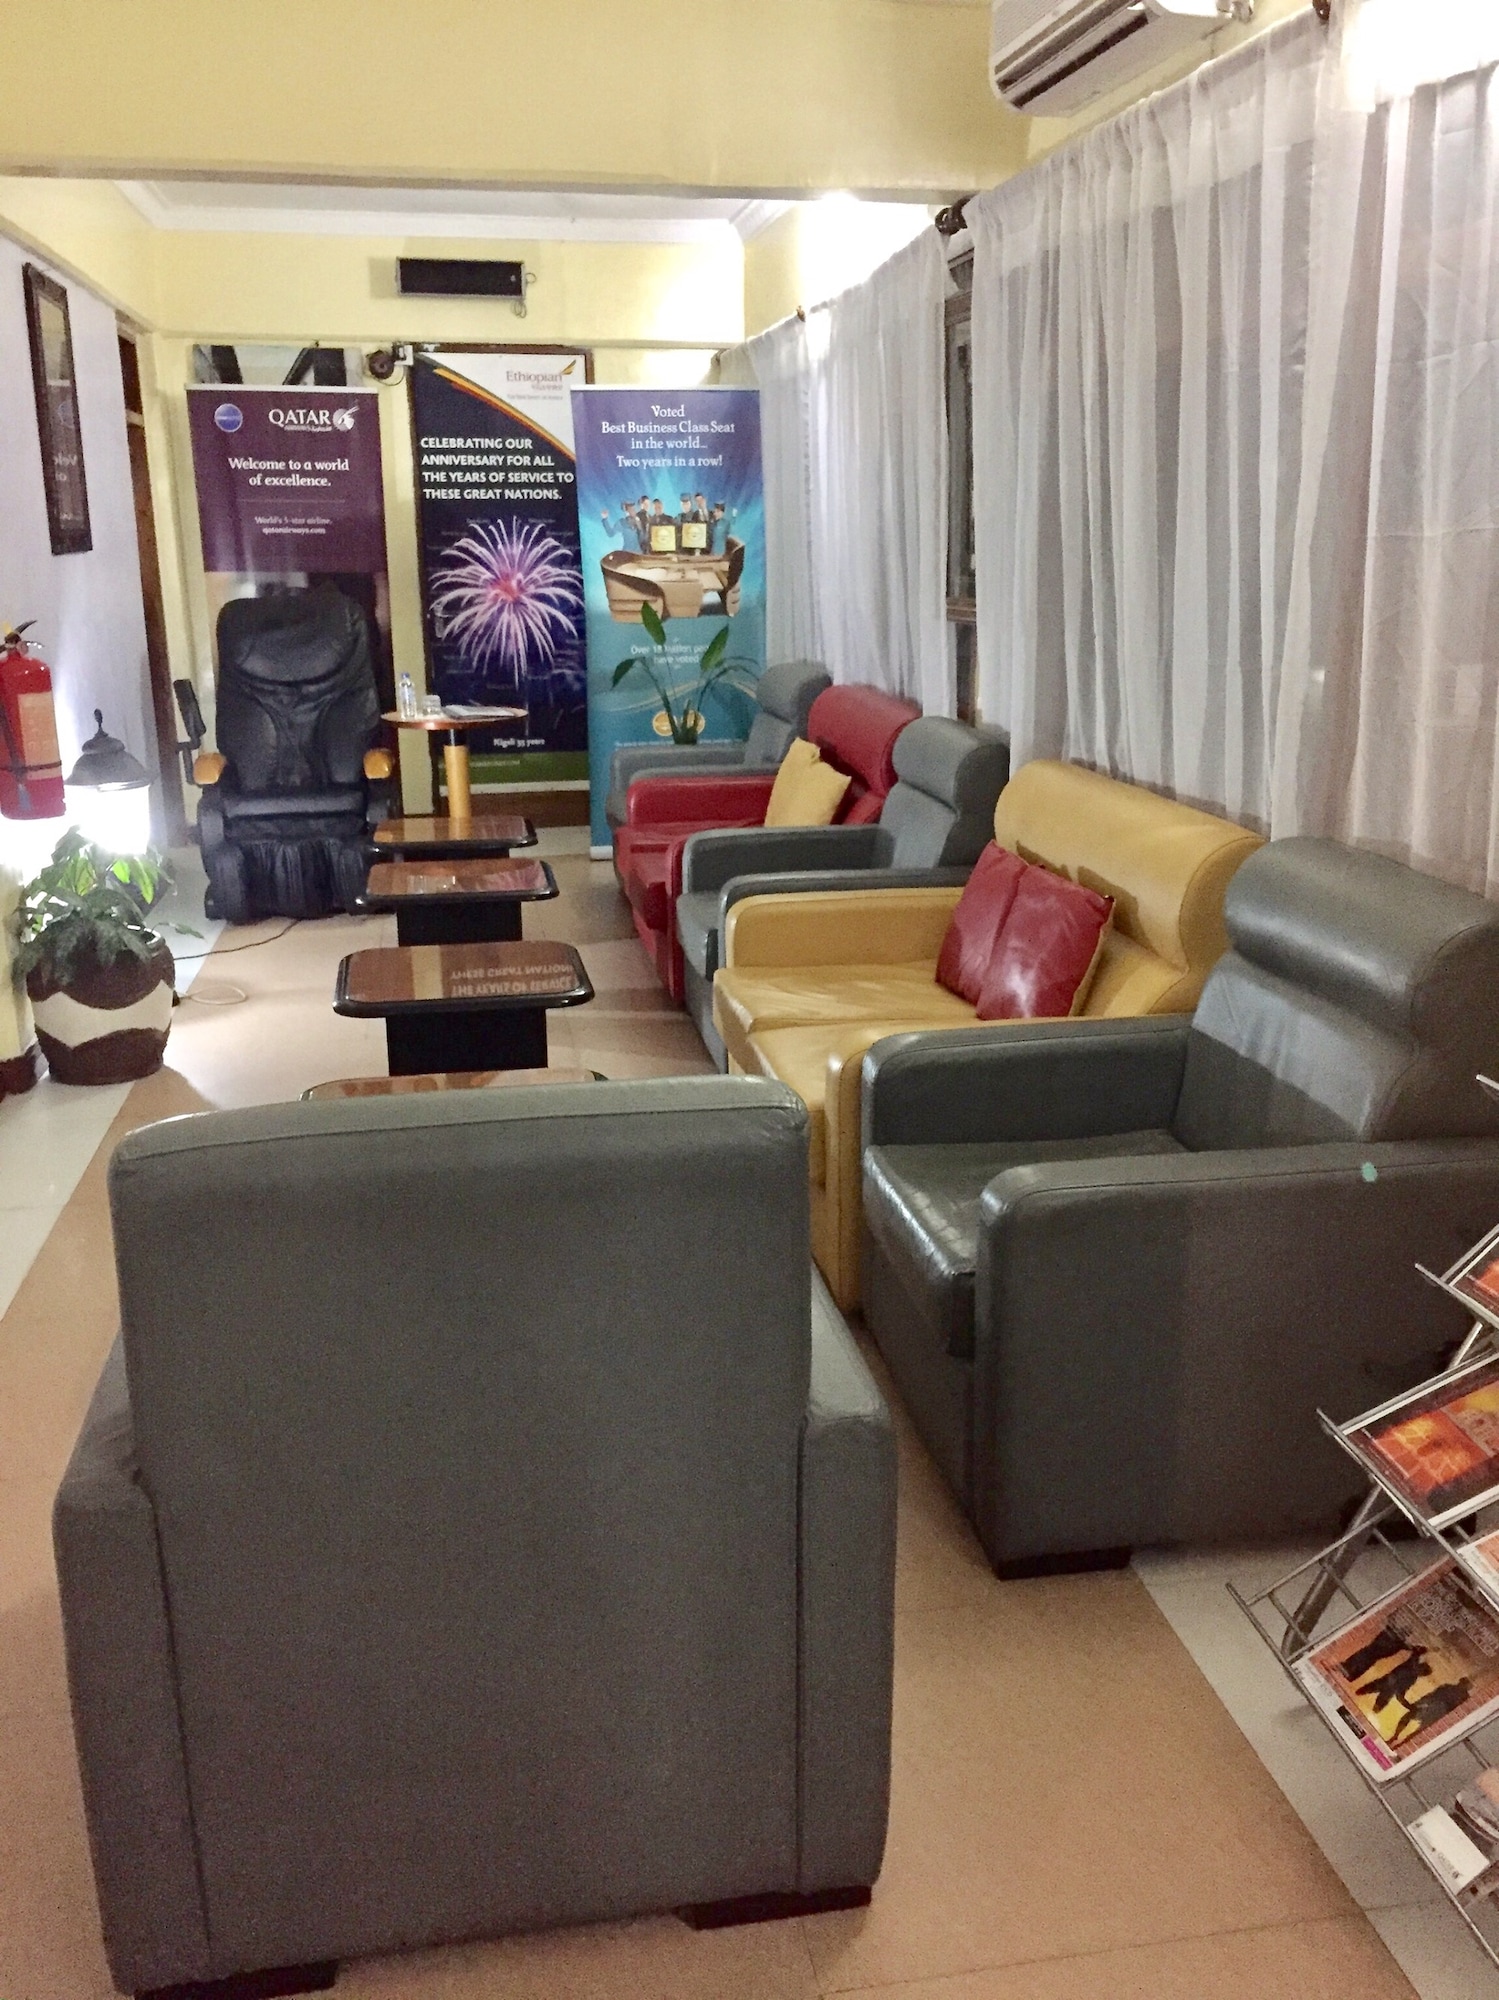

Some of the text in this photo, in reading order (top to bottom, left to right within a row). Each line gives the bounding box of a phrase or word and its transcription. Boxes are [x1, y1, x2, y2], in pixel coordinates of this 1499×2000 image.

[506, 371, 562, 383] Ethiopian
[651, 405, 685, 418] Voted
[268, 408, 331, 428] QATAR
[602, 421, 735, 433] Best Business Class Seat
[420, 437, 533, 449] CELEBRATING OUR
[631, 438, 643, 449] in
[645, 437, 664, 449] the
[228, 457, 349, 471] Welcome to a world
[421, 455, 555, 466] ANNIVERSARY FOR ALL
[616, 455, 723, 469] Two years in a row!
[249, 474, 331, 487] of excellence.
[422, 472, 574, 483] THE YEARS OF SERVICE TO
[423, 489, 562, 500] THESE GREAT NATIONS.
